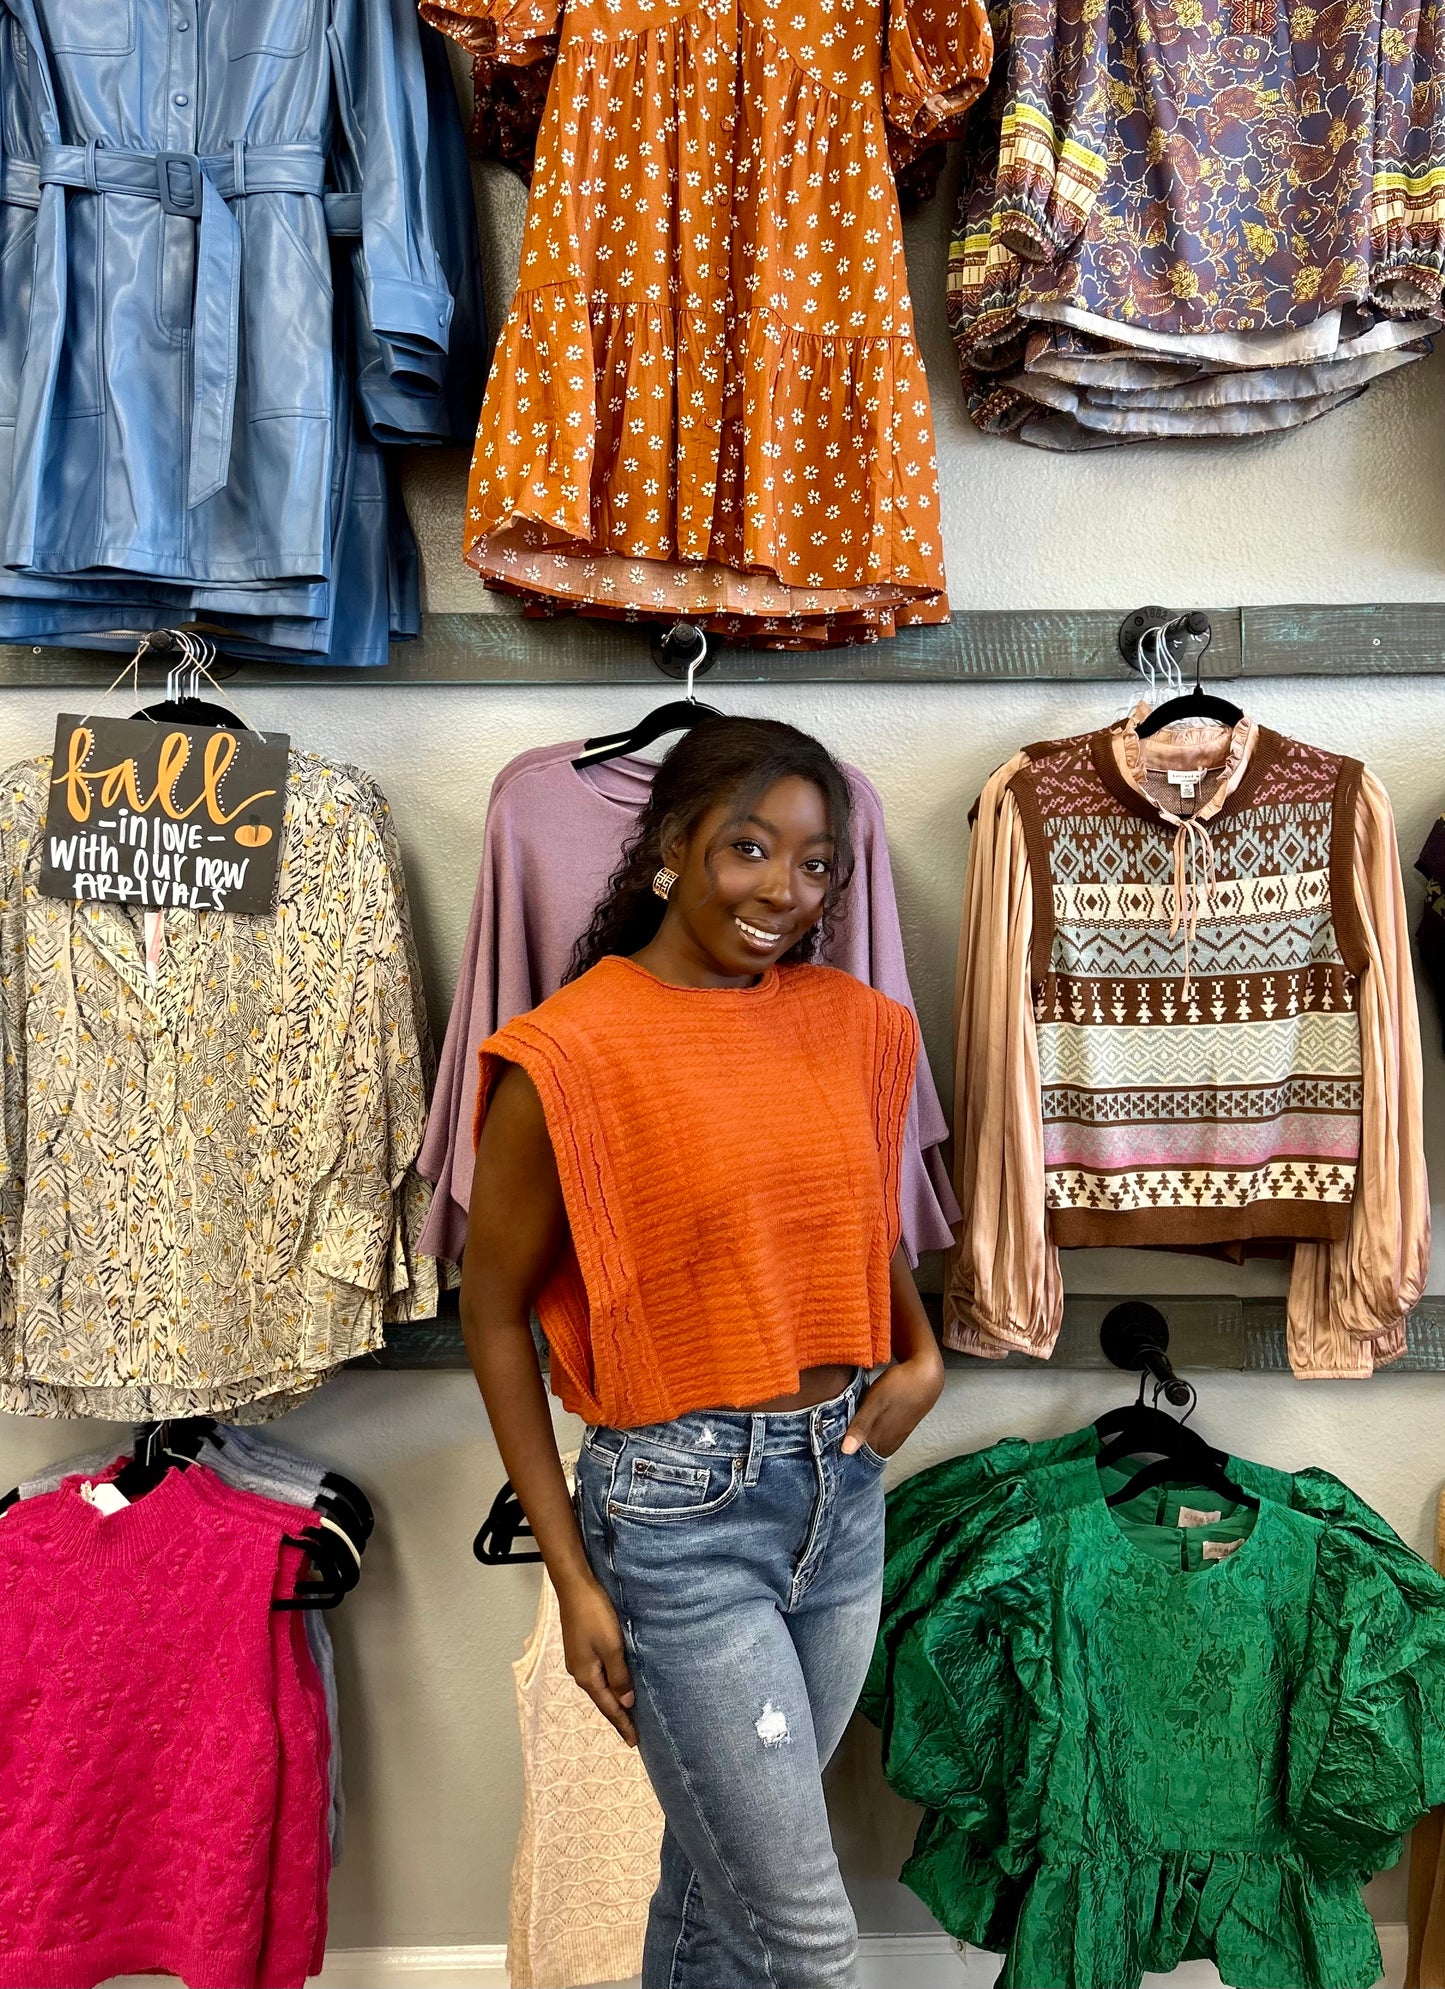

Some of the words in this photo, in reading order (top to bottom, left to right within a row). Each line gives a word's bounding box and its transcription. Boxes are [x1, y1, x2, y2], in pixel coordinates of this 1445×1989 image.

[52, 727, 276, 825] fall
[133, 849, 188, 882] our
[195, 856, 250, 890] new
[73, 872, 228, 912] ARRIVALS
